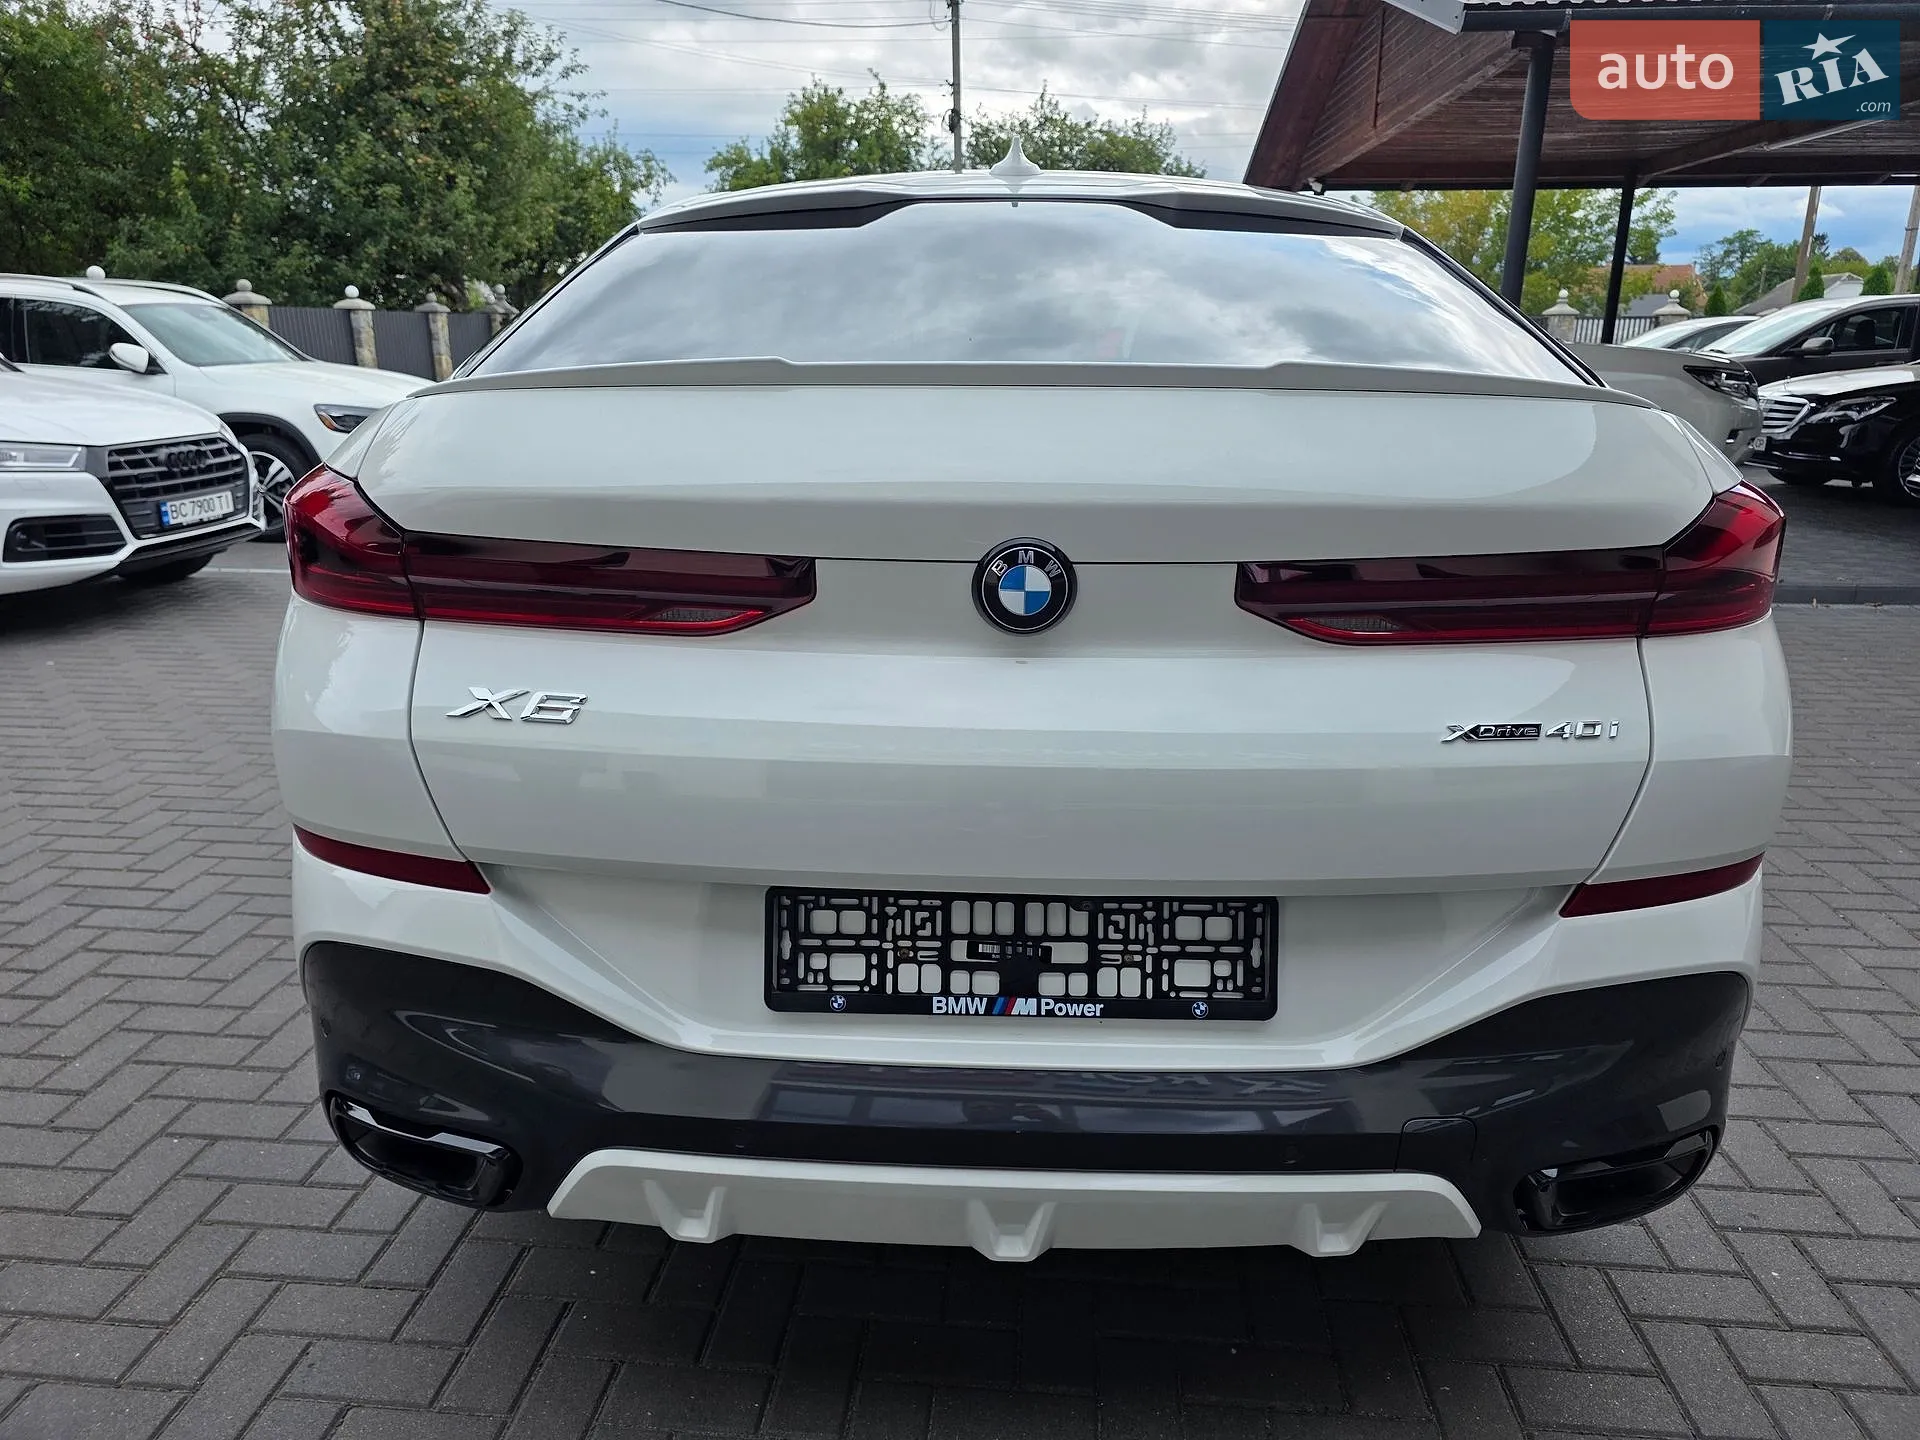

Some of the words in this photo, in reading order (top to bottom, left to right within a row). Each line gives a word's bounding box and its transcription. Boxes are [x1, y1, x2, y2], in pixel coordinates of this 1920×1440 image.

[170, 502, 188, 520] BC
[189, 497, 216, 517] 7900
[991, 549, 1062, 577] BMW
[445, 686, 588, 725] X6
[932, 996, 988, 1015] BMW
[1040, 998, 1104, 1017] Power
